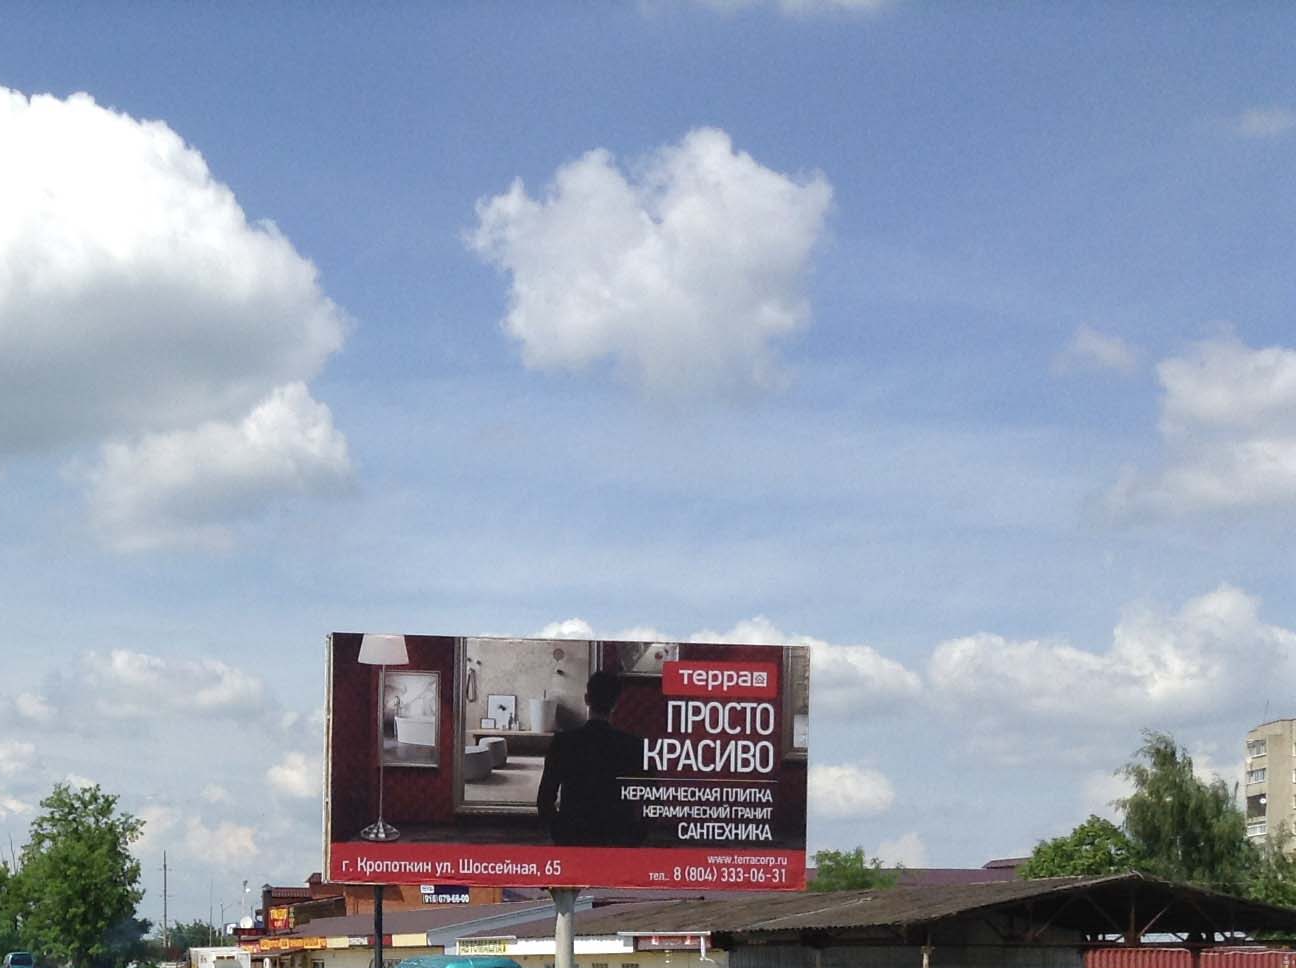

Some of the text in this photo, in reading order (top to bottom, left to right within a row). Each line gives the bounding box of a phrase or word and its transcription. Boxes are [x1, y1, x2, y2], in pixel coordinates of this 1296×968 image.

[679, 669, 751, 691] терра
[667, 700, 775, 736] ПРОСТО
[642, 738, 774, 773] КРАСИВО
[621, 785, 773, 803] КЕРАМИЧЕСКАЯ ПЛИТКА
[642, 804, 773, 820] КЕРАМИЧЕСКИЙ ГРАНИТ
[678, 822, 773, 841] САНТЕХНИКА
[342, 857, 561, 877] г. Кропоткин ул. Шоссейная, 65
[707, 855, 788, 867] www.terracorp.ru
[673, 867, 681, 881] 8
[684, 866, 718, 882] (804)
[721, 867, 786, 883] 333-06-31
